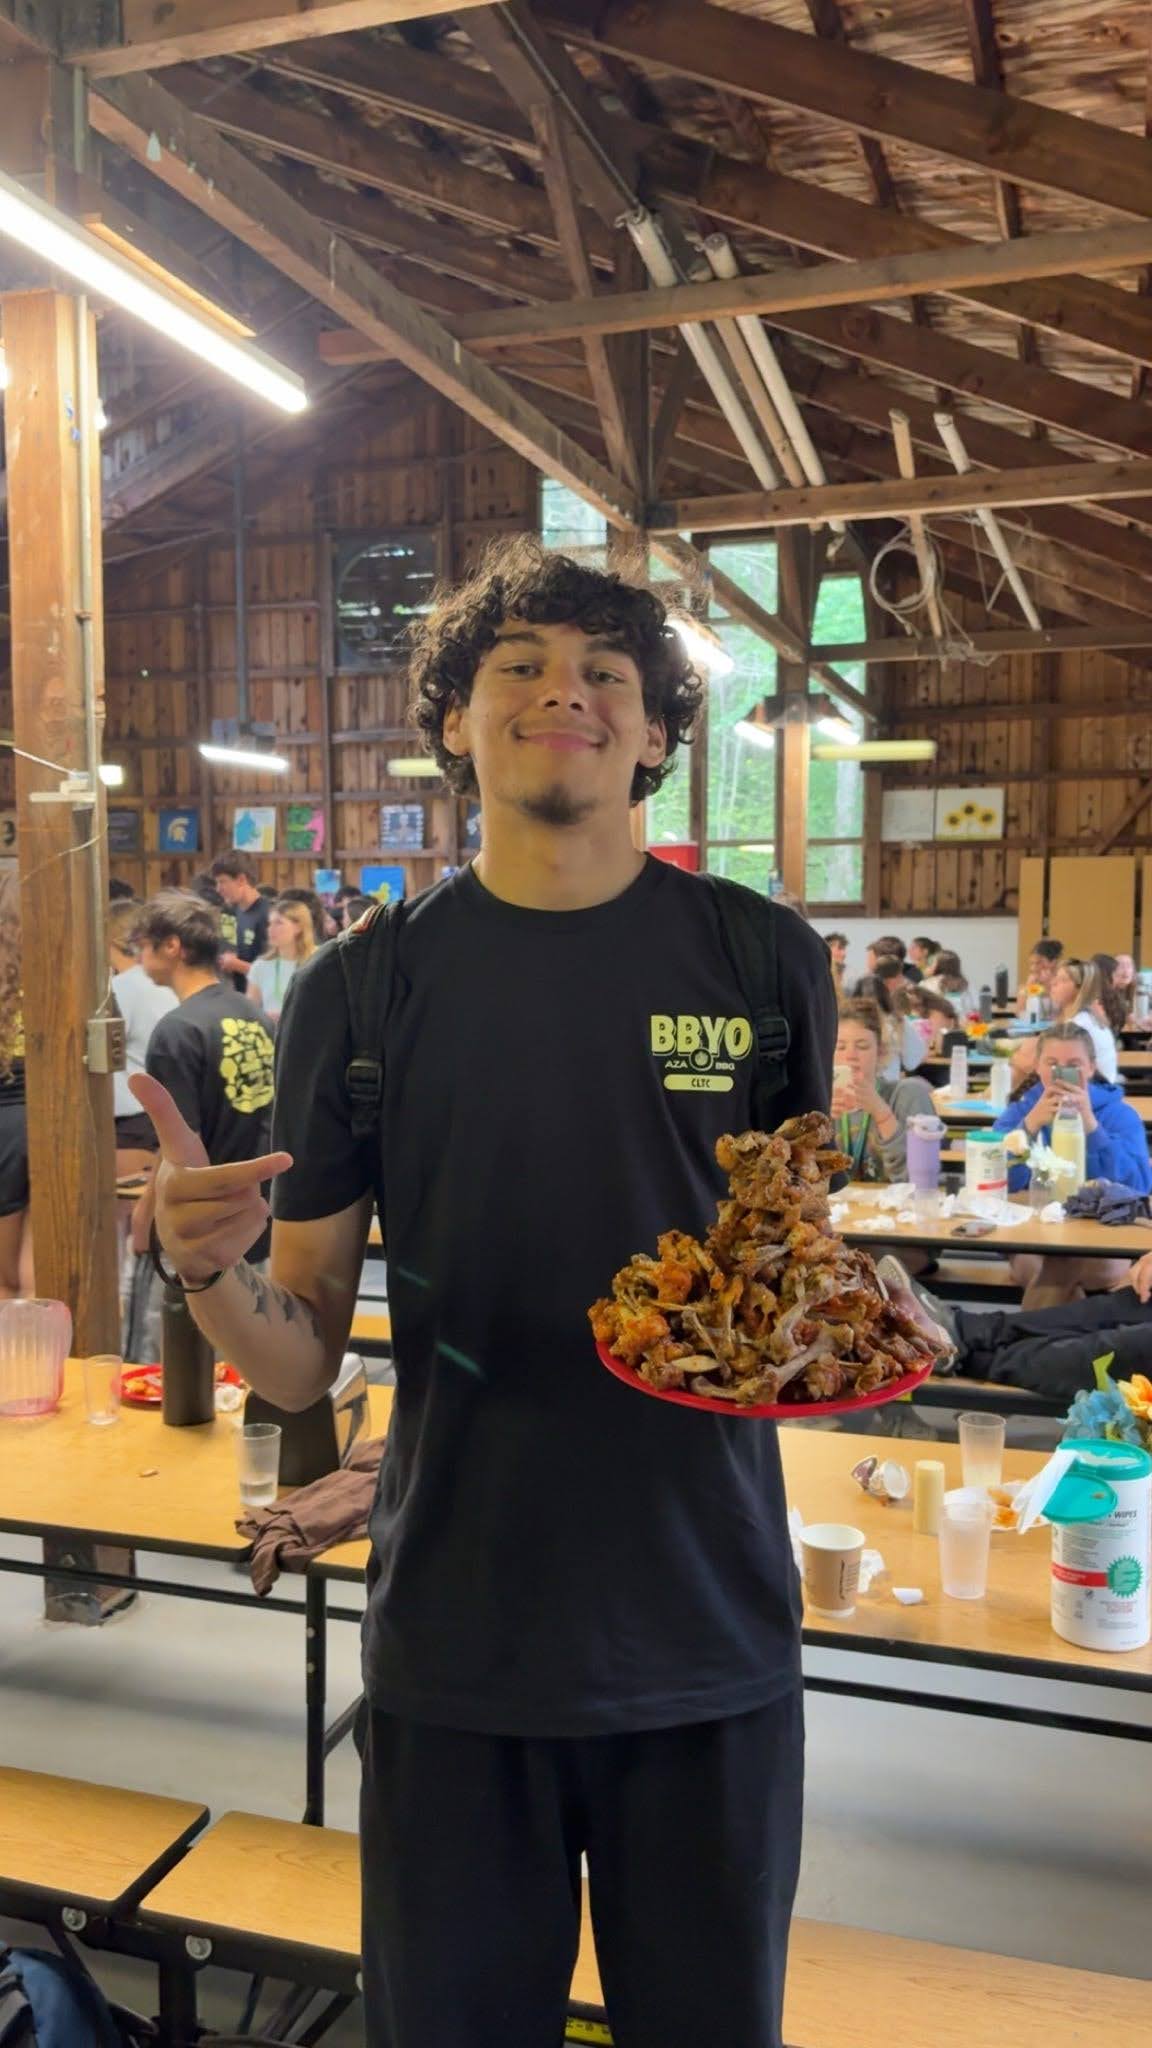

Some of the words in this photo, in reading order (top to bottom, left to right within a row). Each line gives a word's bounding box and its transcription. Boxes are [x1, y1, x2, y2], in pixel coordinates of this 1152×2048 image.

[651, 1015, 753, 1060] BBYO
[664, 1060, 688, 1069] AZA
[715, 1062, 735, 1071] BBG
[691, 1078, 711, 1088] CLTC
[1114, 1510, 1137, 1519] WIPES
